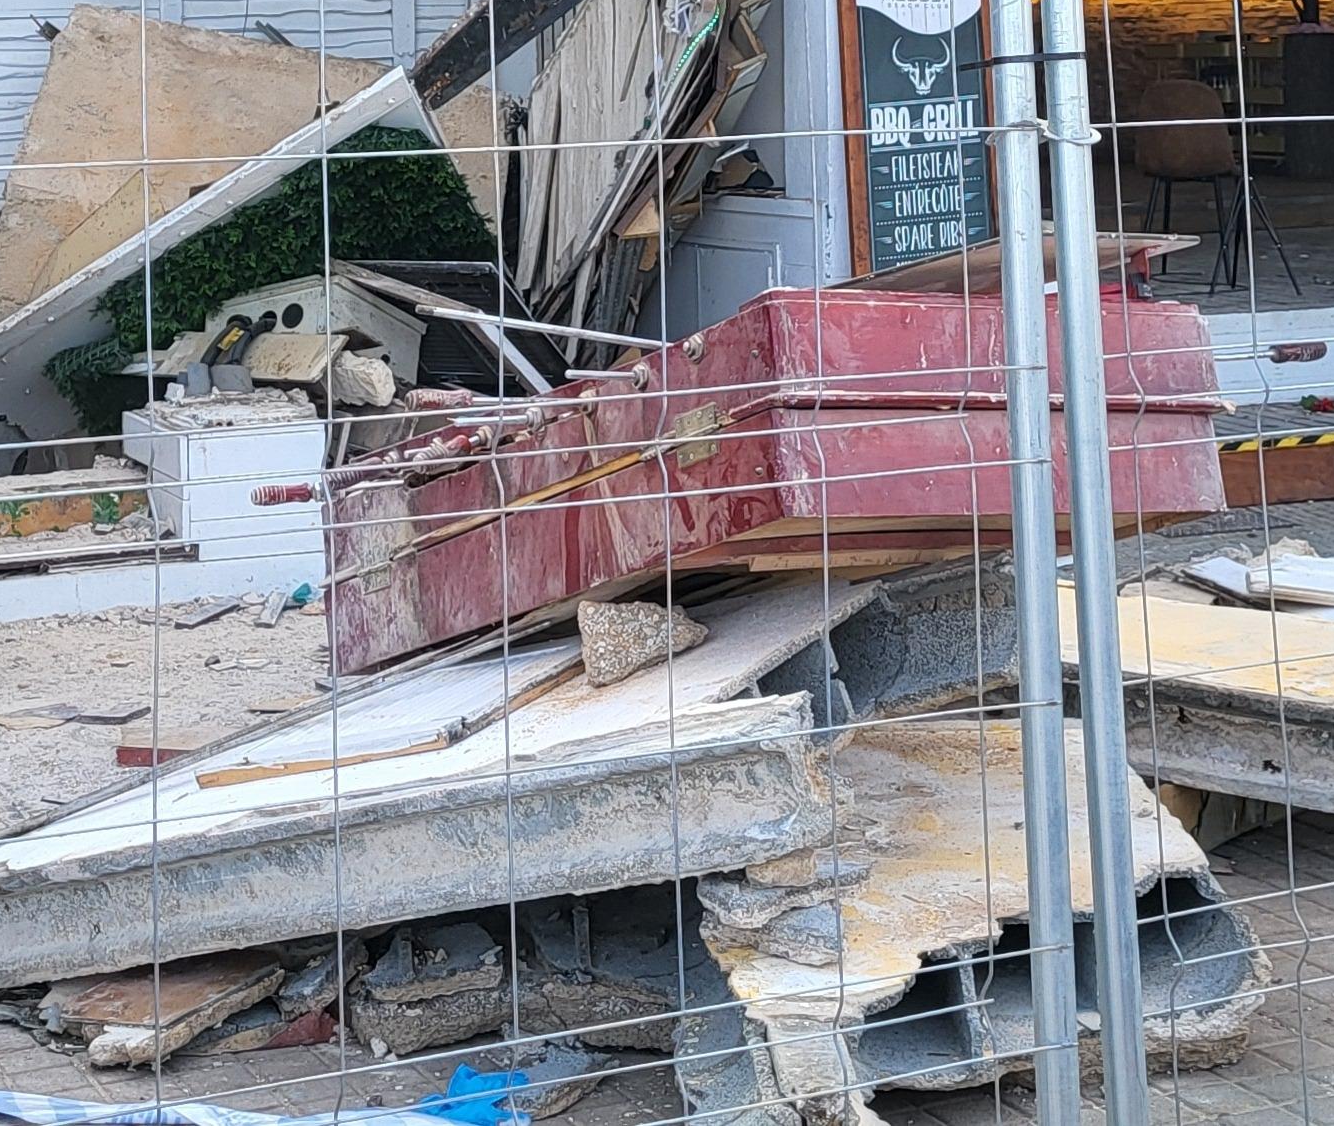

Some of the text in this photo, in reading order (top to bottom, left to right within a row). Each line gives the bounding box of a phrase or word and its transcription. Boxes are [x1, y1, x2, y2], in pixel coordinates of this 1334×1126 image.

[870, 99, 979, 148] BBQ GRILL
[894, 222, 935, 253] SPARE
